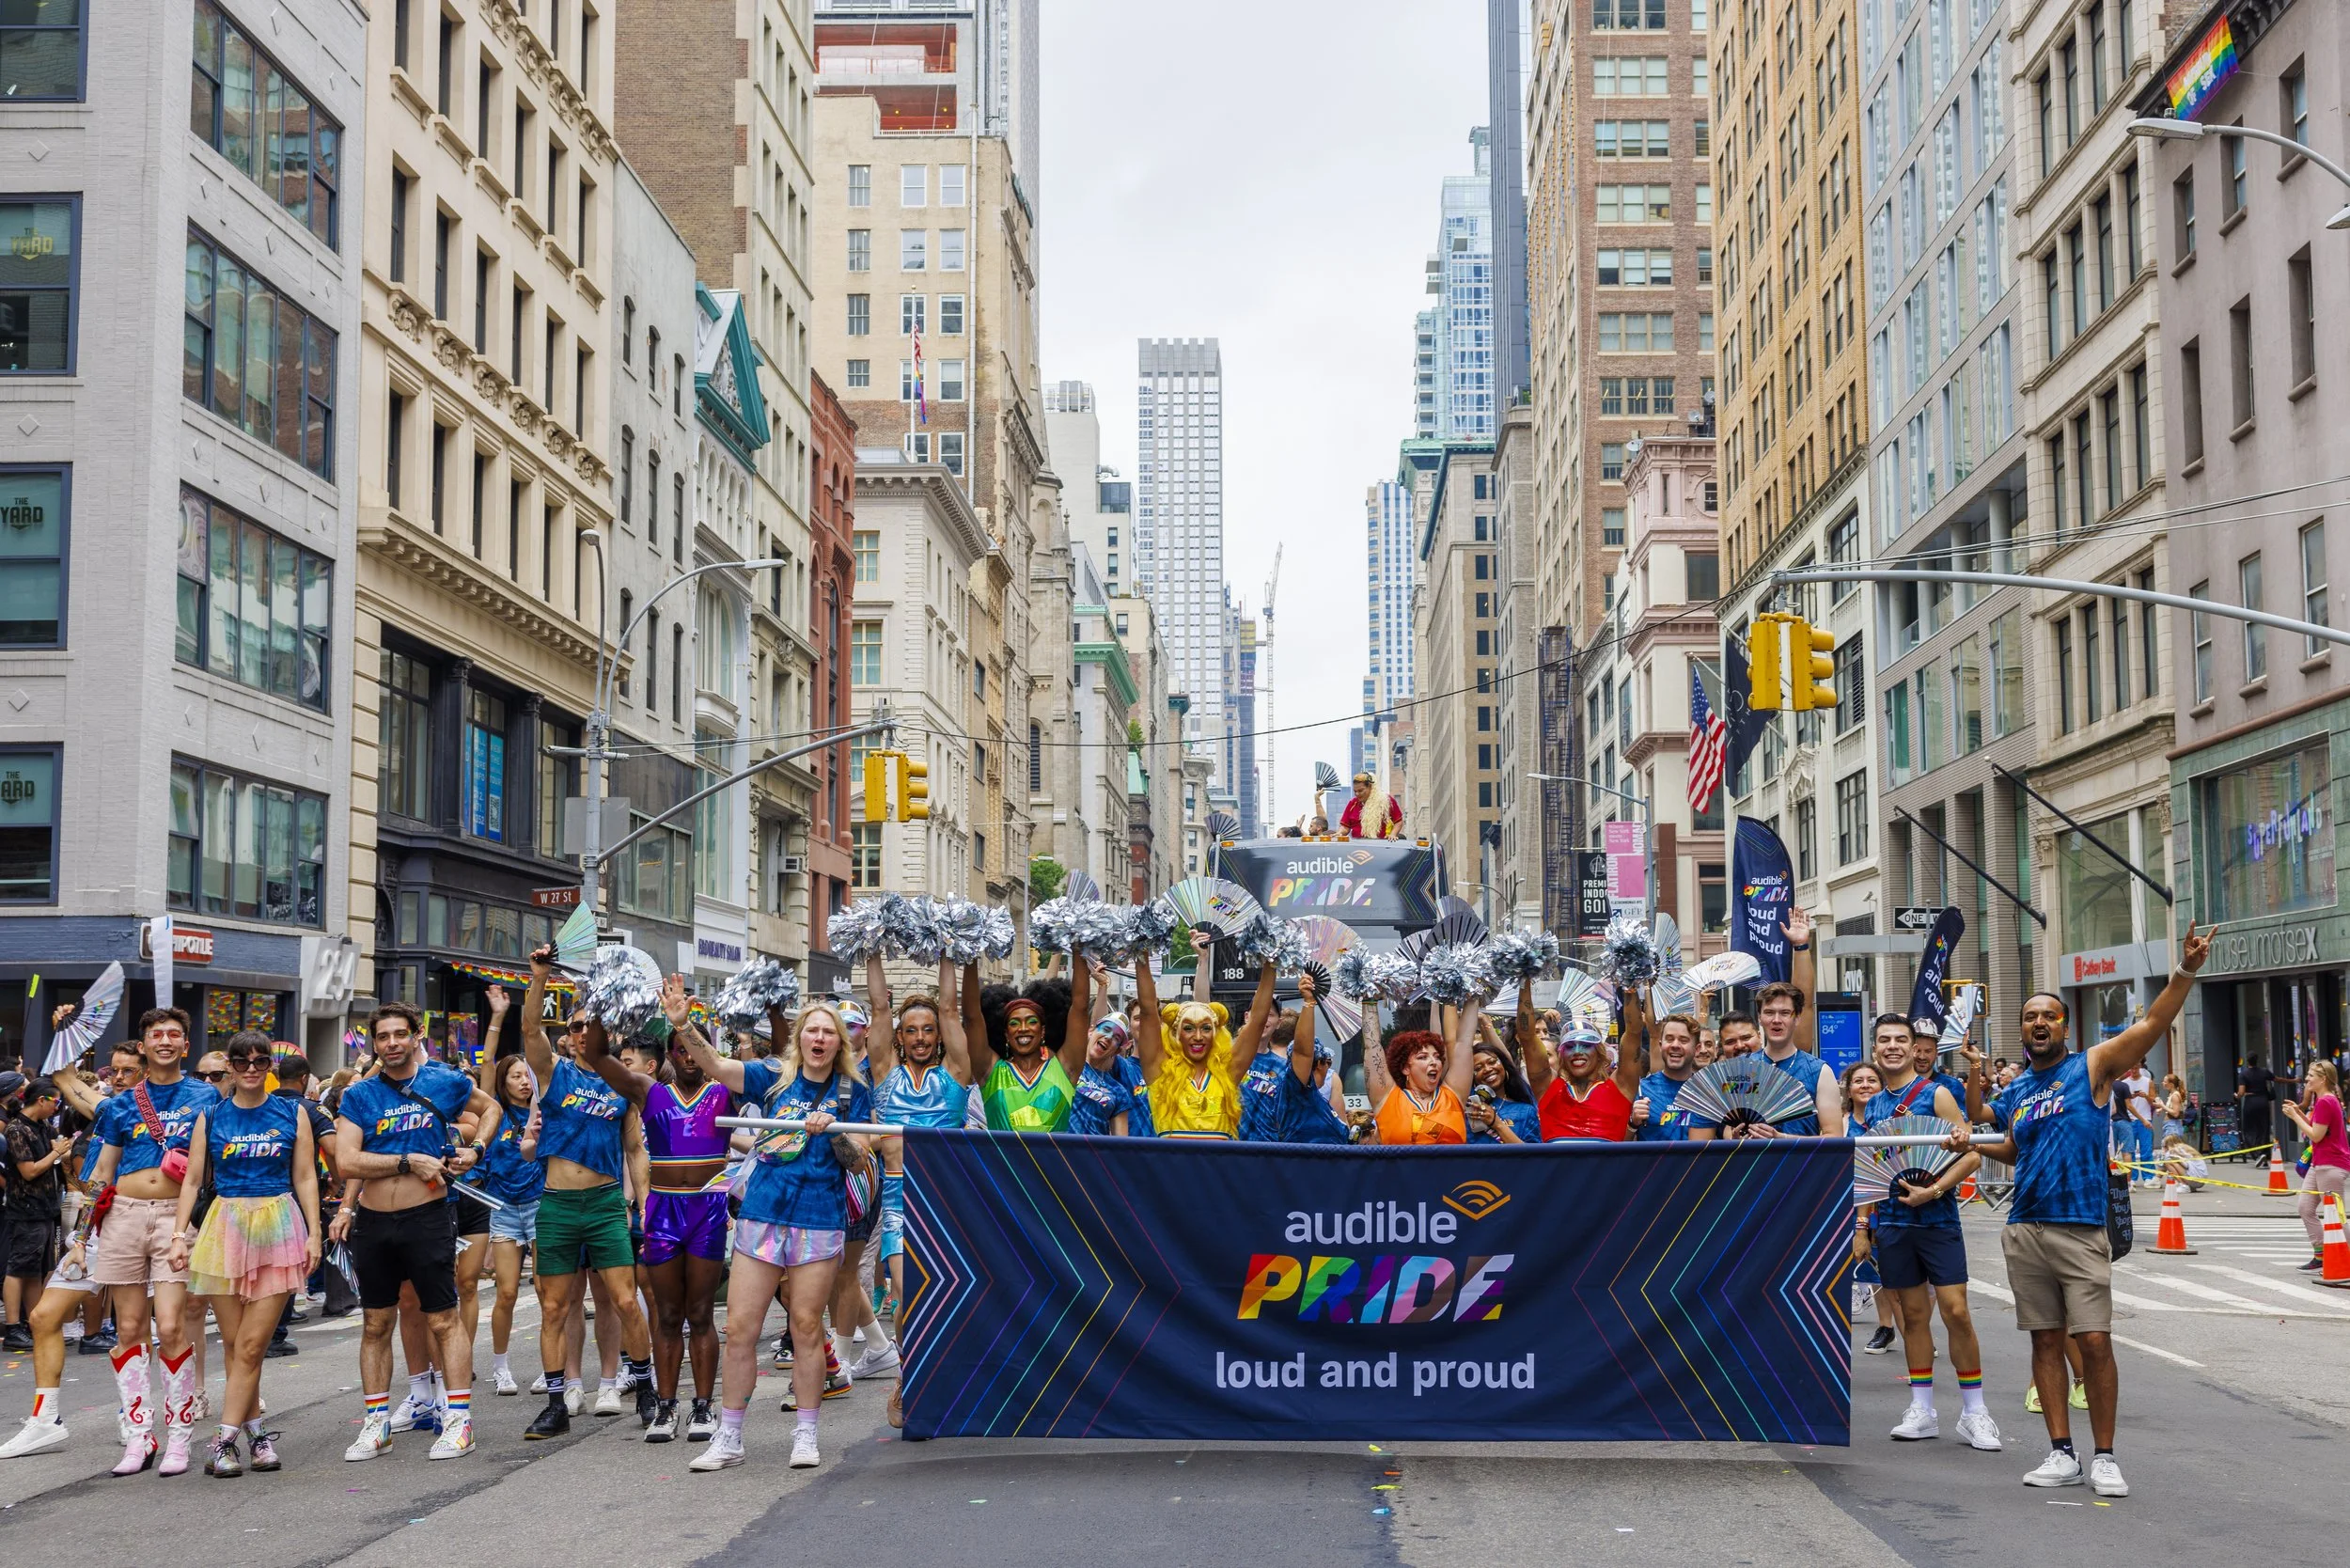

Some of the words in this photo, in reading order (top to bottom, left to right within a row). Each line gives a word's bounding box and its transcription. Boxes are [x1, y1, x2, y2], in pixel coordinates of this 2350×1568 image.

[0, 507, 43, 524] YARD
[1286, 857, 1354, 874] audible
[1751, 876, 1782, 886] audible
[540, 893, 548, 904] W
[551, 892, 560, 902] 27
[563, 891, 572, 902] St
[1269, 878, 1376, 906] PRIDE
[1747, 902, 1778, 920] loud
[1904, 914, 1923, 923] ONE
[1747, 917, 1771, 936] and
[1749, 931, 1783, 955] proud
[727, 944, 741, 962] SALON
[1222, 968, 1245, 980] 188
[2101, 956, 2116, 974] Bank
[312, 949, 354, 1001] 234
[1722, 1083, 1760, 1094] PRIDE
[384, 1104, 421, 1117] audible
[561, 1094, 619, 1120] PRIDE
[376, 1112, 433, 1135] PRIDE
[231, 1134, 271, 1143] audible
[223, 1142, 282, 1159] PRIDE
[1285, 1201, 1457, 1245] audible
[1237, 1254, 1514, 1324] PRIDE
[1215, 1352, 1305, 1389] loud
[1320, 1352, 1397, 1388] and
[1413, 1353, 1535, 1397] proud
